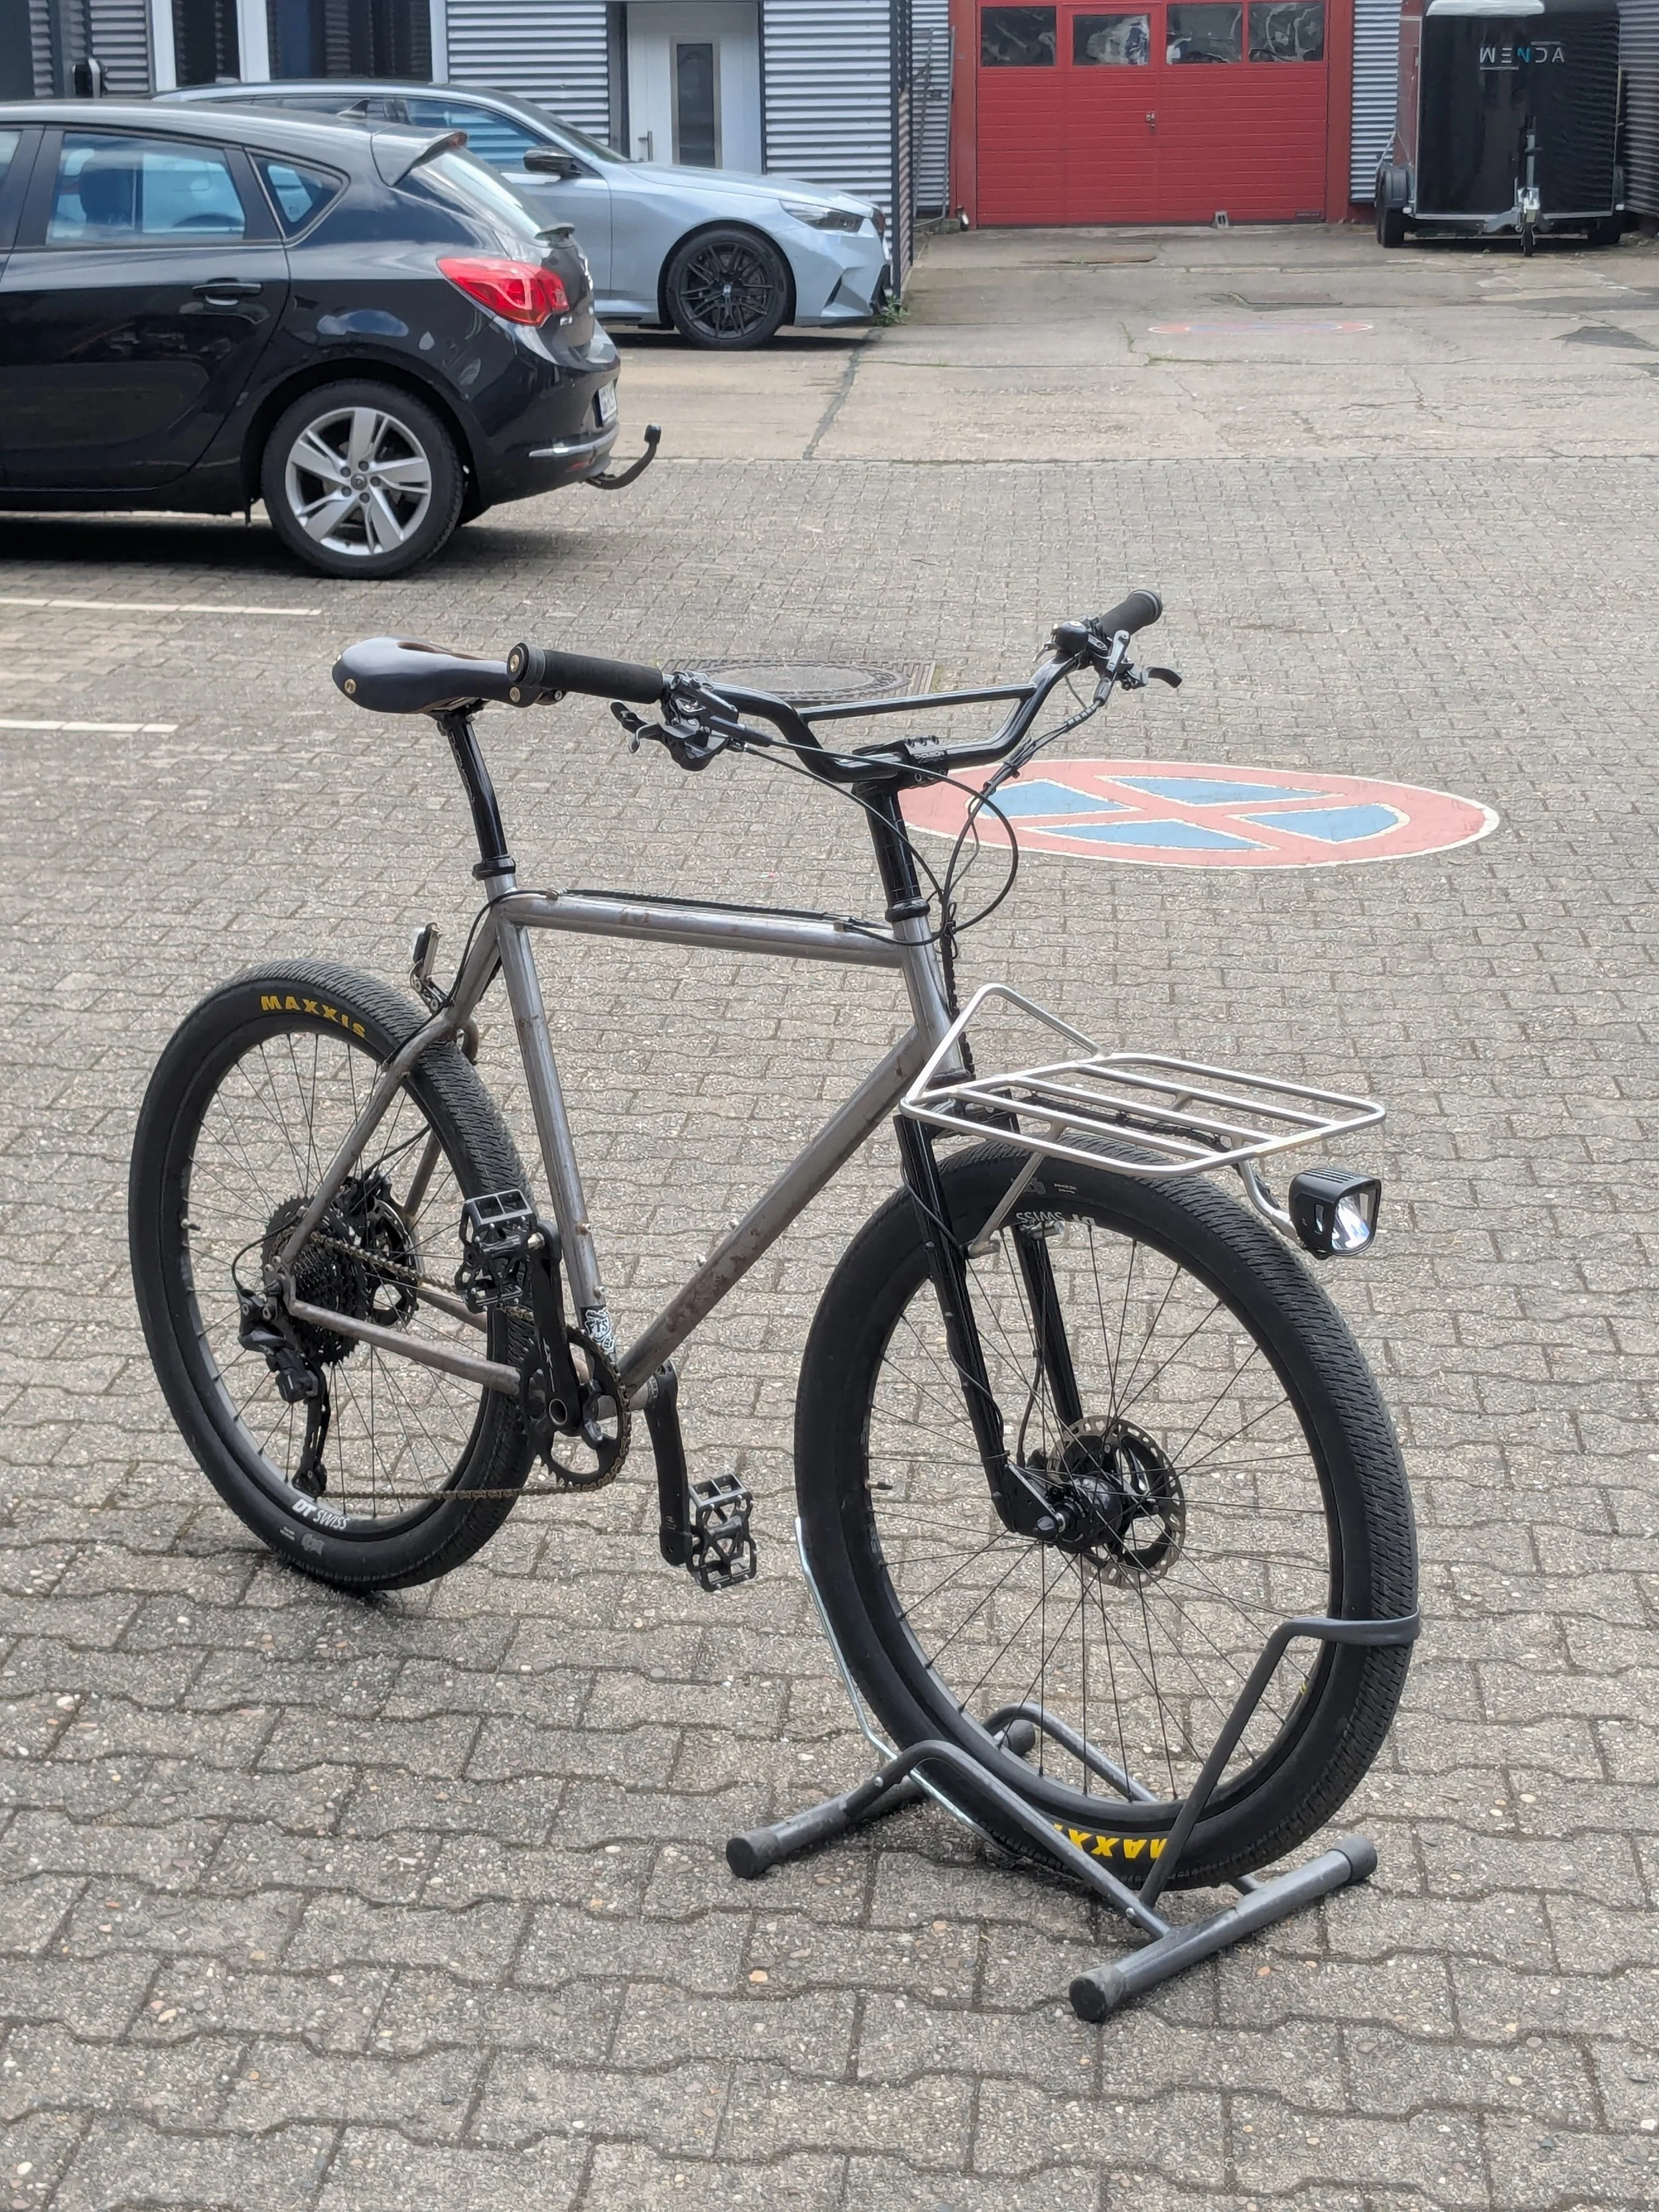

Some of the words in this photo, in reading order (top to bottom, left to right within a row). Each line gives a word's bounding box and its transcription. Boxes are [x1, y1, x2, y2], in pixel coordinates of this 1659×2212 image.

[1479, 46, 1565, 64] WENDA
[261, 995, 365, 1038] MAXXIS
[1015, 1211, 1066, 1224] SWISS
[292, 1498, 317, 1517] DT
[313, 1509, 350, 1531] SWISS
